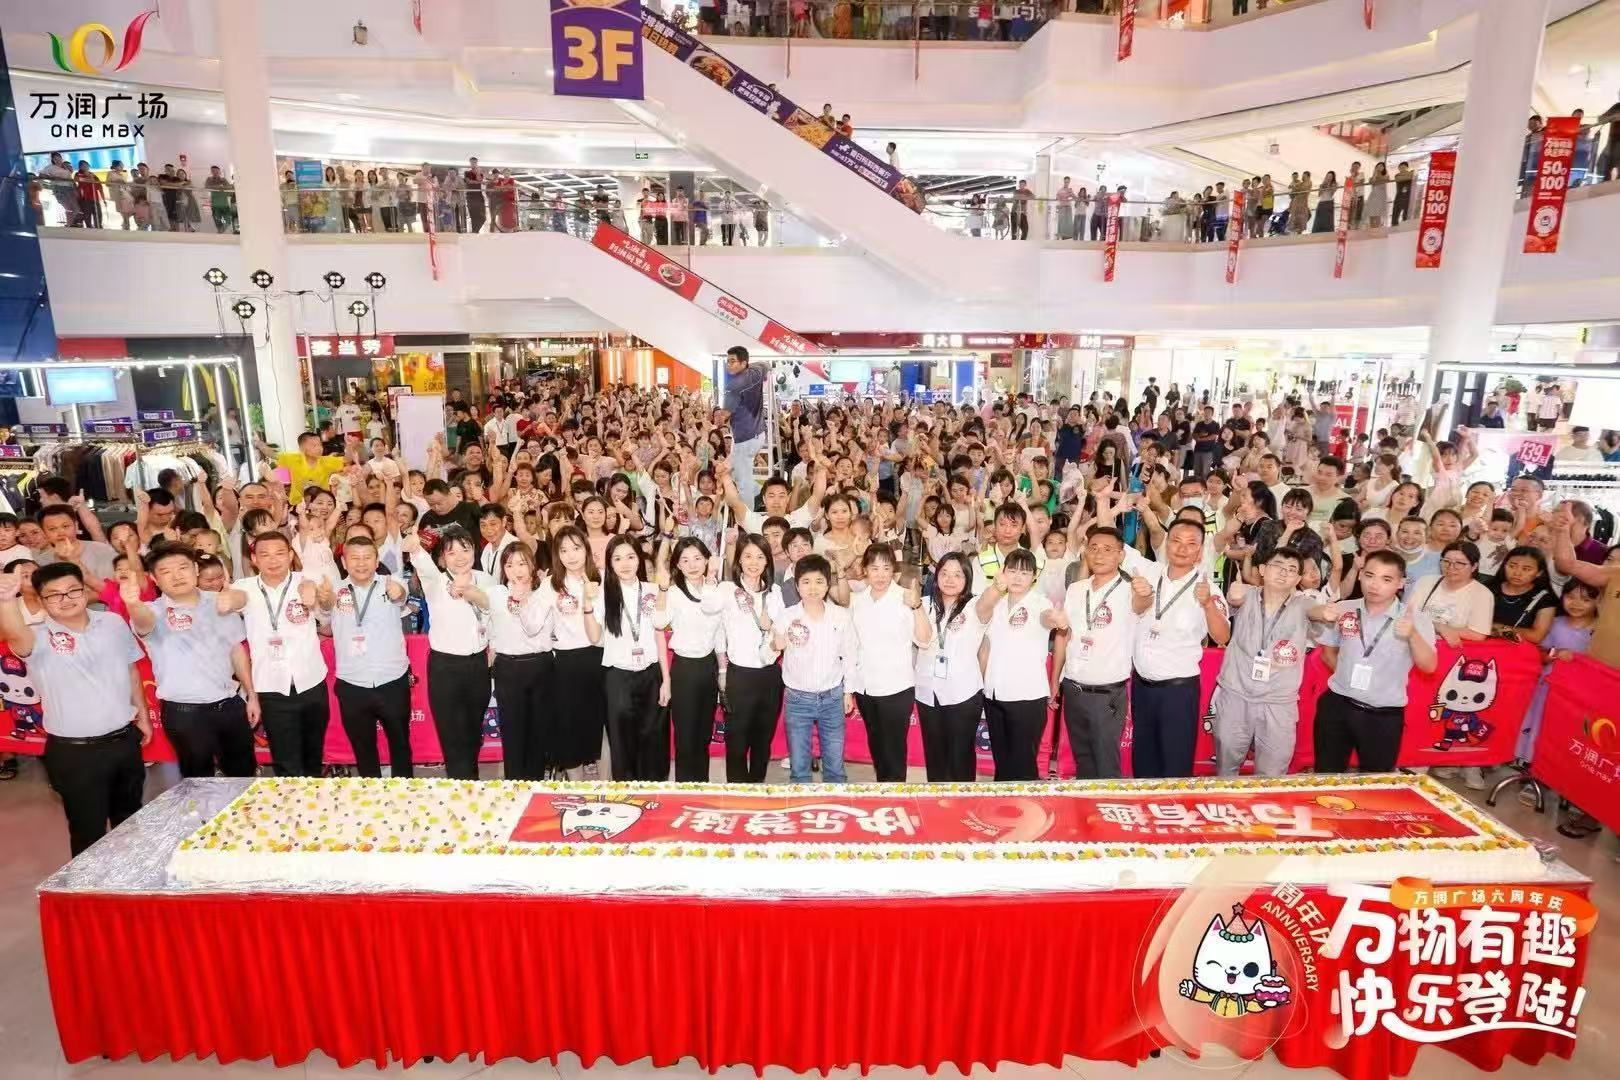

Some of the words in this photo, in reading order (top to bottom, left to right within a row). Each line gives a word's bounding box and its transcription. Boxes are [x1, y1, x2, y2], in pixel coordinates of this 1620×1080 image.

[563, 26, 634, 82] 3F
[1539, 176, 1564, 190] 100
[1425, 203, 1446, 214] 100
[310, 339, 381, 356] 麦当劳
[1521, 441, 1544, 462] 139
[1096, 802, 1334, 838] 万物有趣
